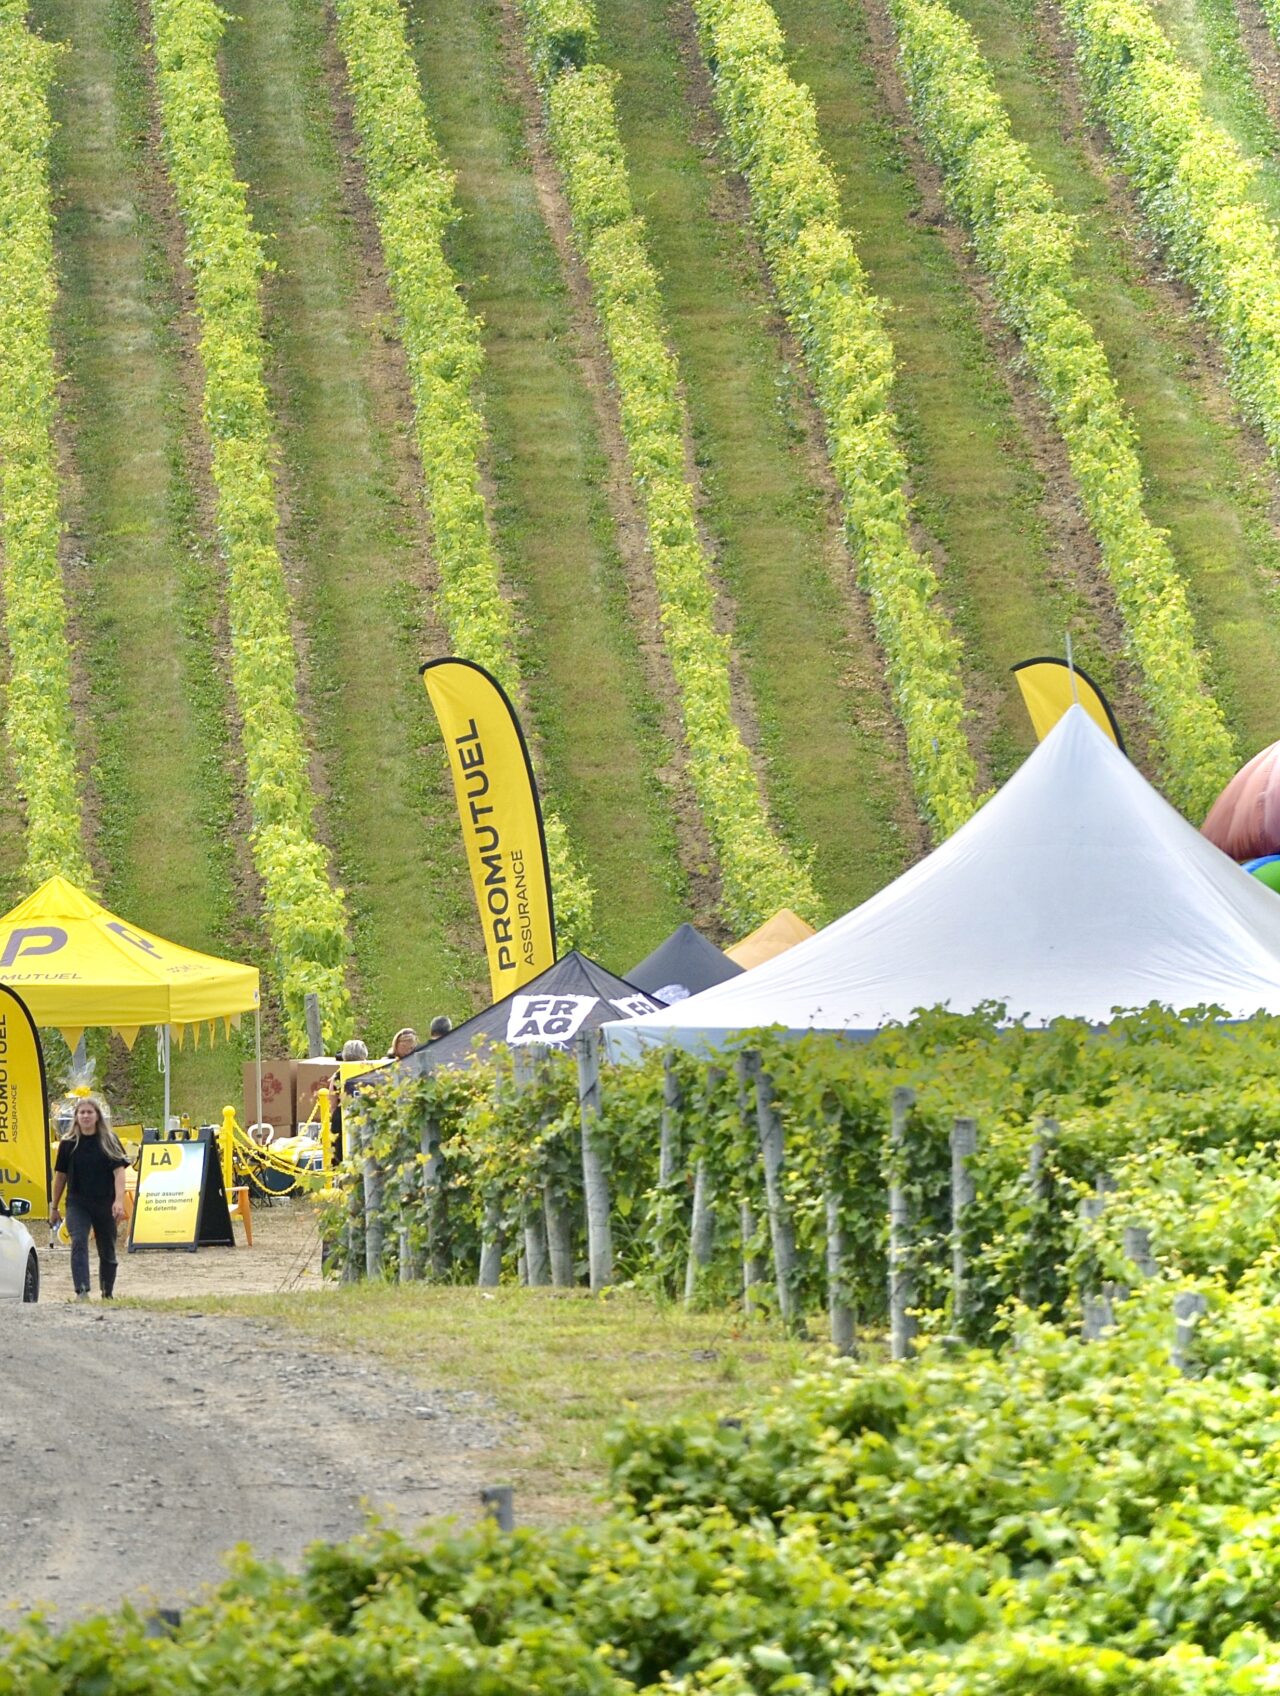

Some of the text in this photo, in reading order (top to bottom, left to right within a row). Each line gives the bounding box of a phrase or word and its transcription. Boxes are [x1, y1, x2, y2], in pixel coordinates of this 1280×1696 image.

[456, 718, 517, 971] PROMUTUEL
[511, 849, 535, 966] ASSURANCE
[514, 1017, 572, 1038] AQ
[523, 999, 578, 1018] FR
[10, 1084, 18, 1143] ASSURANCE
[150, 1148, 172, 1166] LÀ
